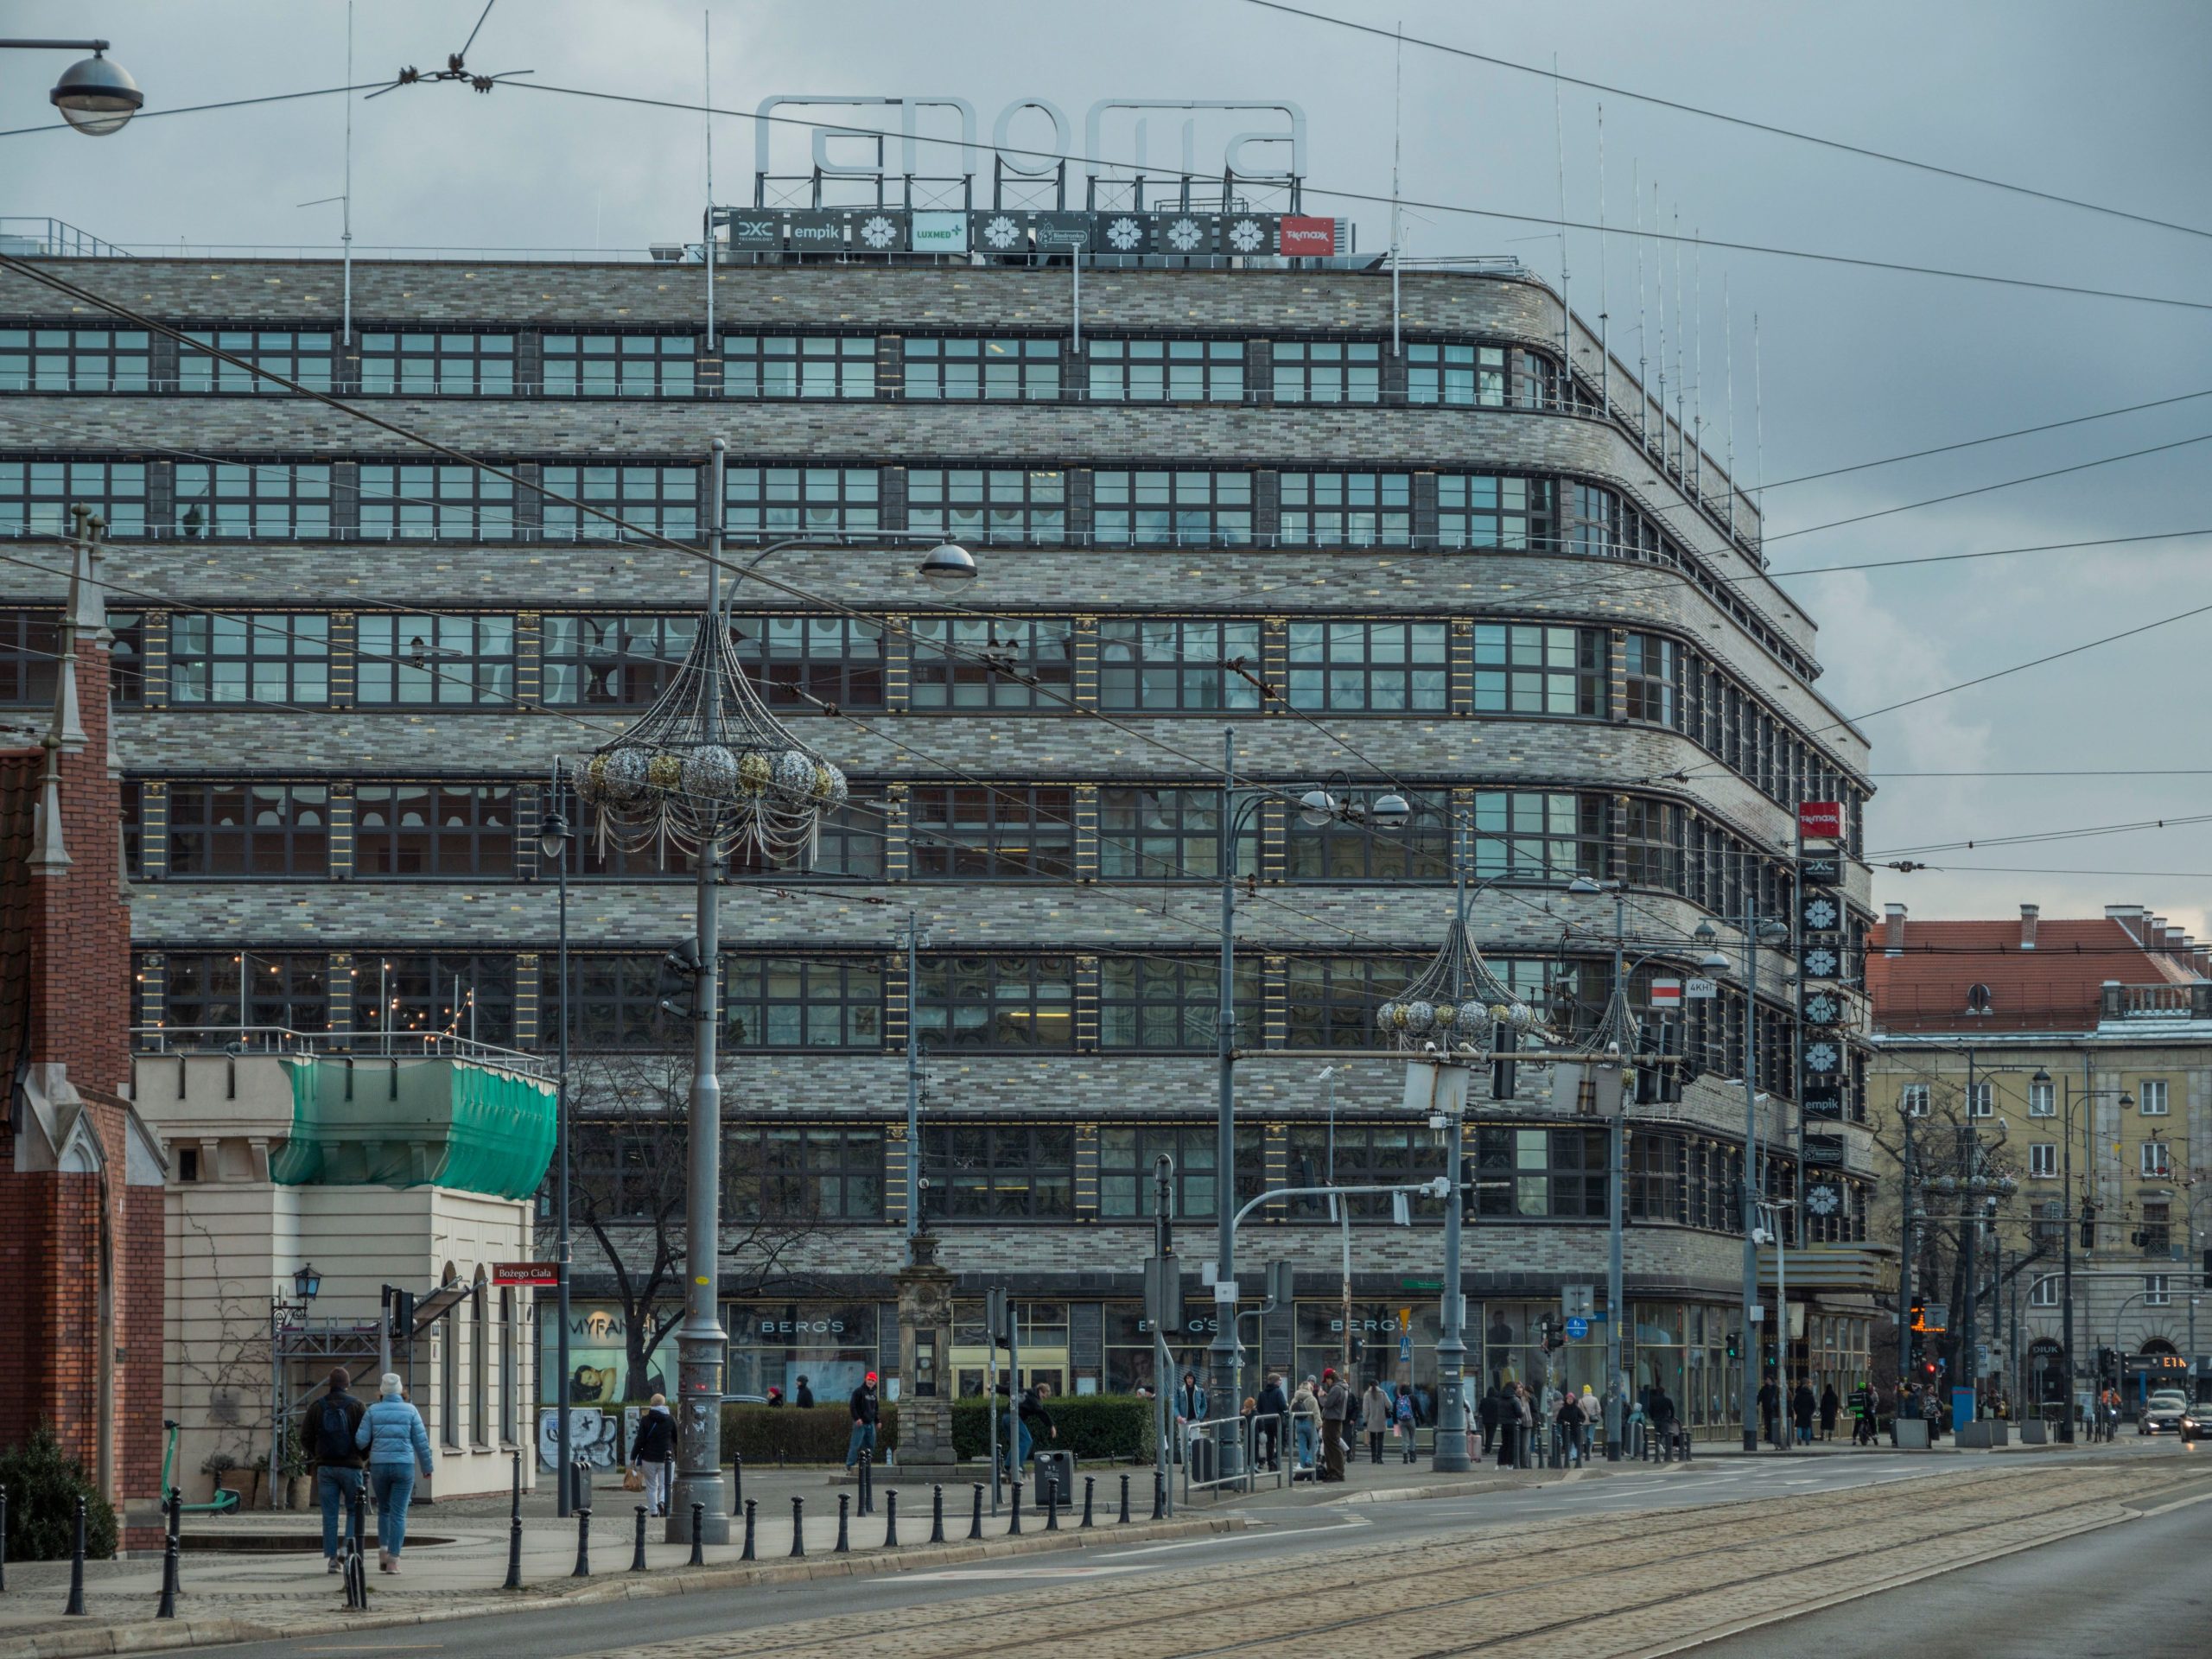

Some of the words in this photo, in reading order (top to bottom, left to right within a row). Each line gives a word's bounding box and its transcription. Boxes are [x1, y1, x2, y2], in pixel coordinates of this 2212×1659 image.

[739, 221, 773, 236] DXC
[794, 223, 839, 240] empik
[917, 230, 950, 239] LUXMED
[1805, 1096, 1839, 1111] empik
[499, 1268, 529, 1280] Bożego
[531, 1268, 551, 1277] Ciała
[761, 1319, 844, 1332] BERG'S
